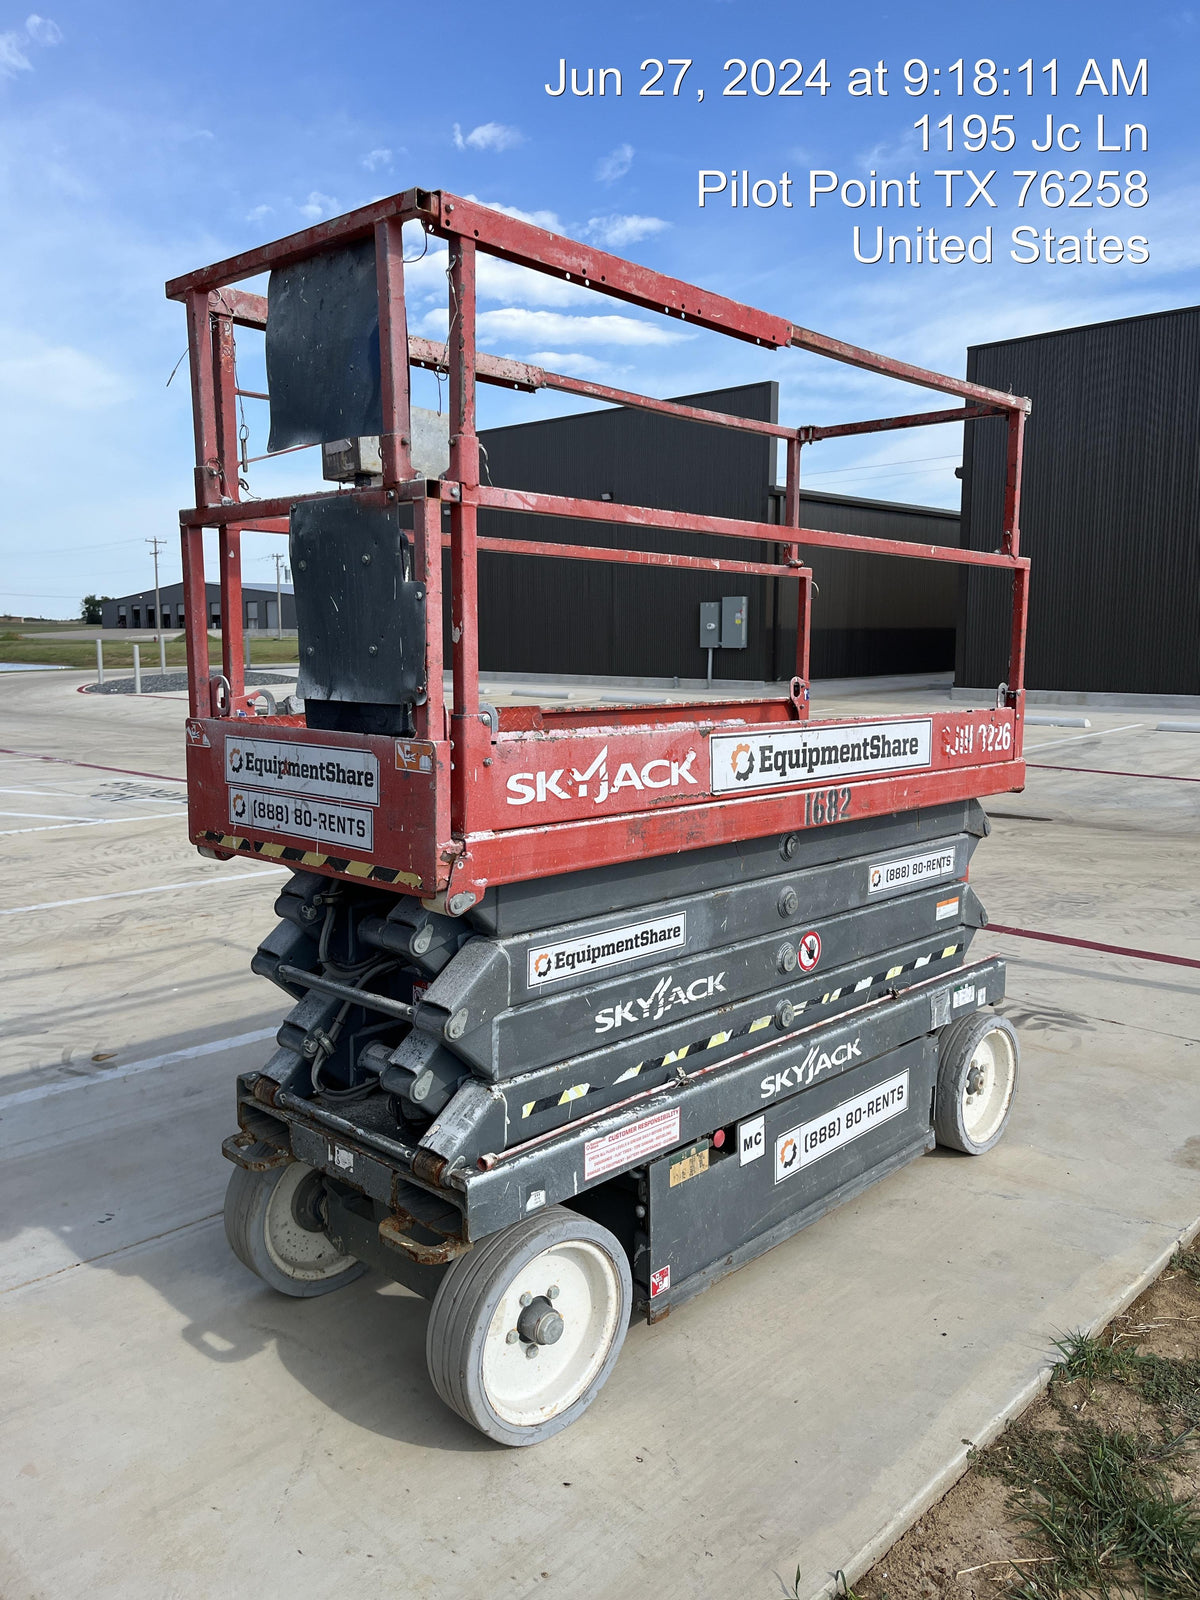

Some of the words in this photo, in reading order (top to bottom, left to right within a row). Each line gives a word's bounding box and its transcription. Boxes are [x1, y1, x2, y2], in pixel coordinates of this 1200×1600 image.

[245, 751, 375, 788] EquipmentShare
[506, 744, 699, 806] SKYJACK
[758, 734, 919, 777] EquipmentShare
[252, 799, 289, 825] (888)
[293, 807, 366, 838] 80-RENTS
[804, 786, 852, 827] 1682
[885, 864, 910, 883] (888)
[912, 855, 952, 875] 80-RENTS
[554, 923, 682, 970] EquipmentShare
[594, 971, 728, 1034] SKYJACK
[760, 1037, 863, 1099] SKYJACK
[804, 1116, 841, 1153] (888)
[845, 1084, 905, 1130] 80-RENTS
[743, 1131, 762, 1152] MC
